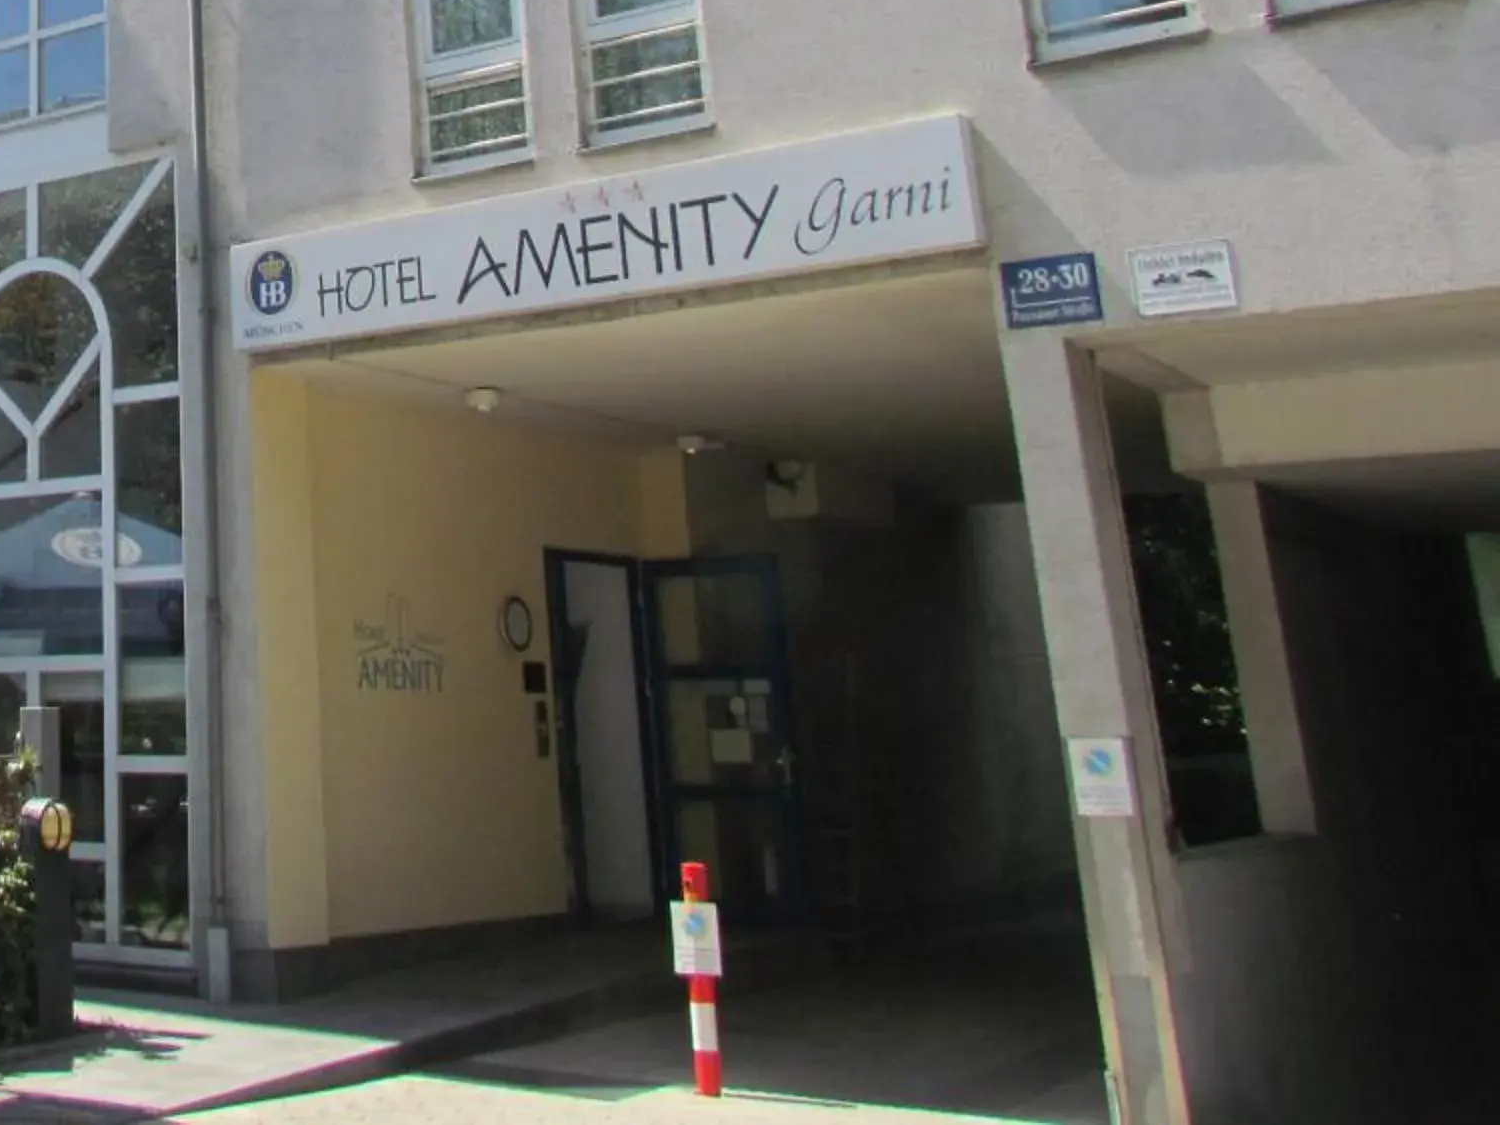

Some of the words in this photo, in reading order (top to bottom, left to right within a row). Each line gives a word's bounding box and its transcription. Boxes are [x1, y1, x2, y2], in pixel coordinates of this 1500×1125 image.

[316, 255, 437, 318] HOTEL
[456, 183, 780, 305] AMENITY
[259, 280, 286, 308] HB
[357, 656, 444, 693] AMENITY
